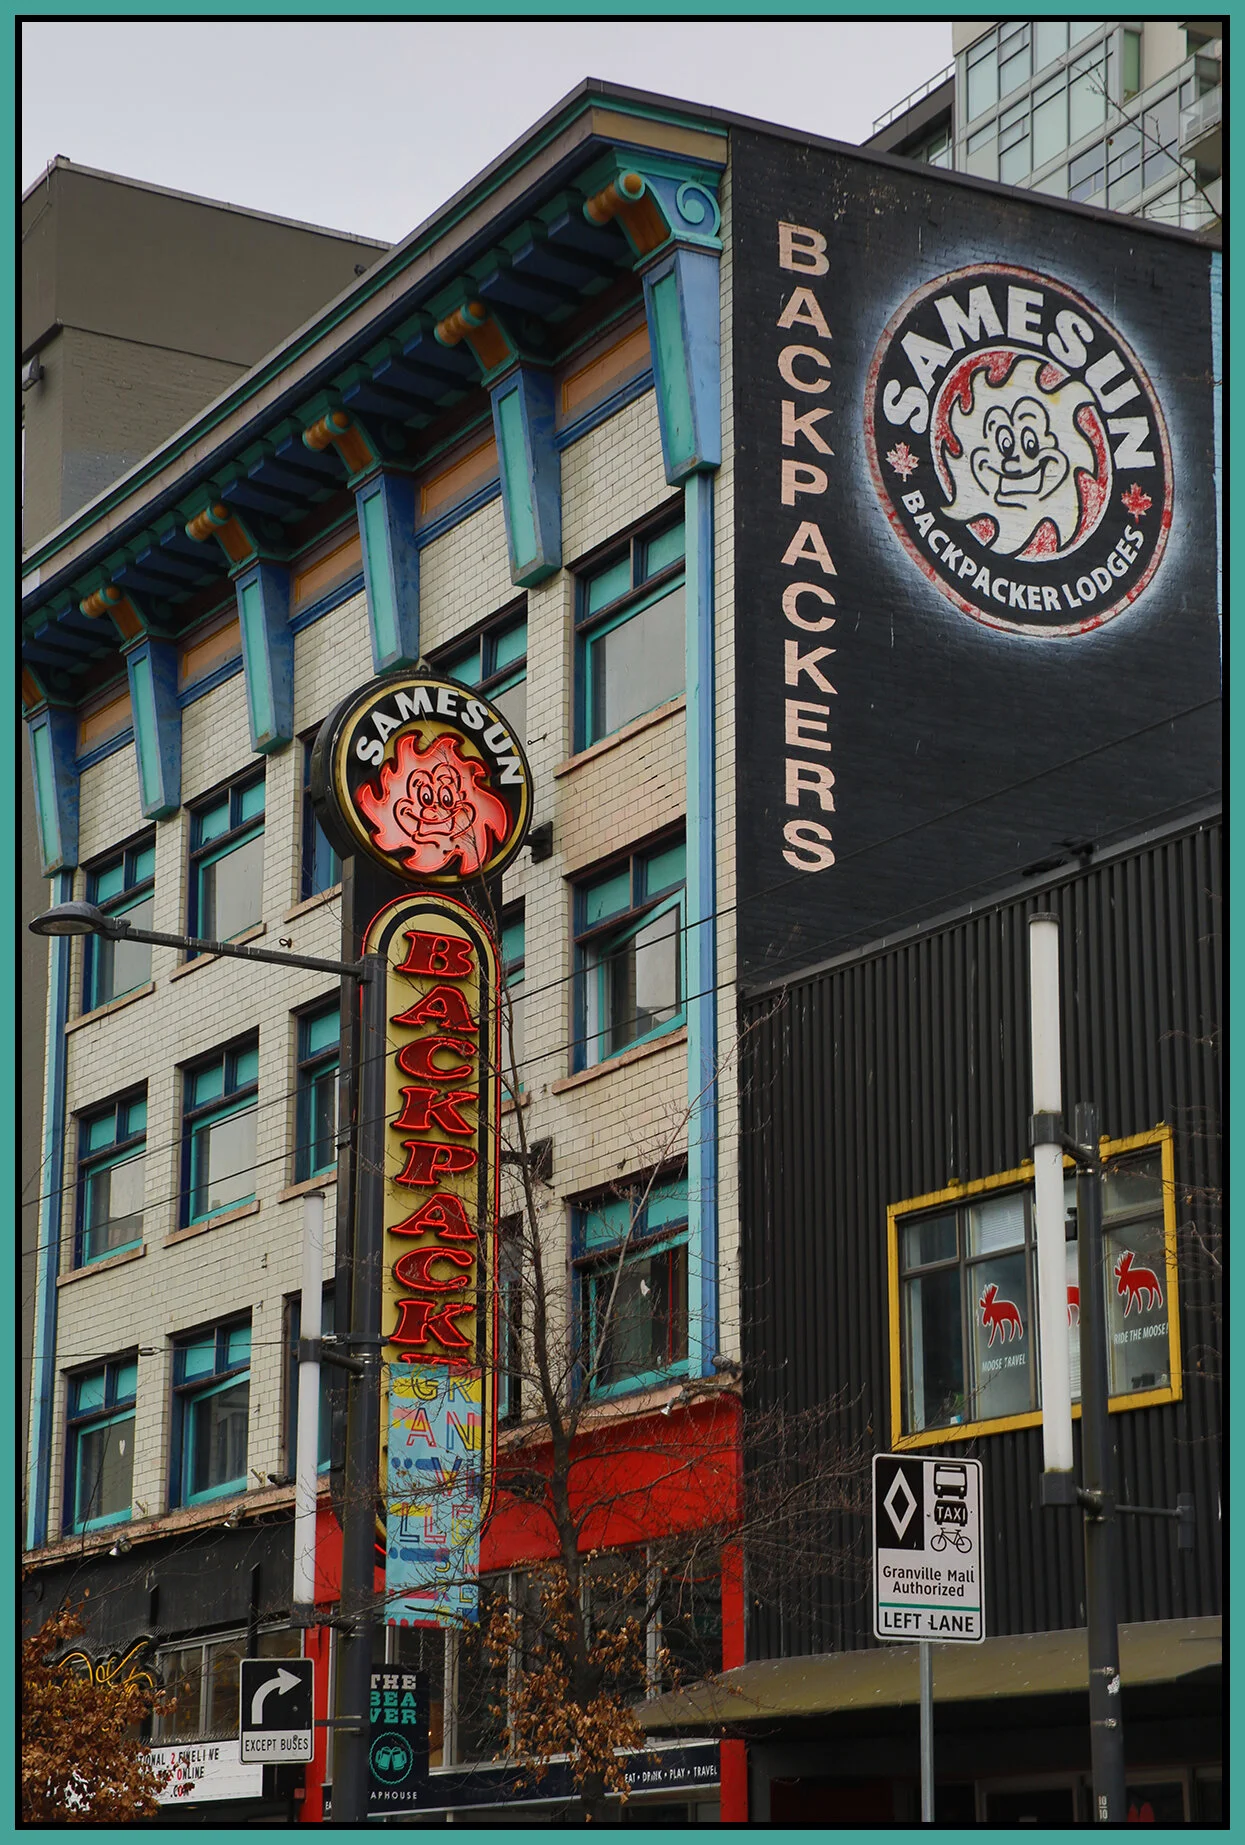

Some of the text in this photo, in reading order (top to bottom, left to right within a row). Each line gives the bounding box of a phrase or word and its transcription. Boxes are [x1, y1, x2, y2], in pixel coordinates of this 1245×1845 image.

[882, 285, 1156, 470] SAMESUN
[776, 220, 838, 874] BACKPACKERS
[901, 489, 1145, 611] BACKPACKER LODGES
[355, 687, 525, 785] SAMESUN
[389, 929, 480, 1365] BACKPACK
[1114, 1322, 1169, 1345] RIDE THE MOOSE!
[982, 1353, 1026, 1372] MOOSE TRAVEL
[936, 1505, 966, 1521] TAXI
[883, 1565, 975, 1583] Granville Mall
[893, 1581, 965, 1597] Authorized
[884, 1611, 974, 1632] LEFT LANE
[370, 1674, 416, 1690] THE
[370, 1691, 416, 1707] BEA
[369, 1708, 416, 1724] VER
[245, 1738, 309, 1752] EXCEPT BUSES
[625, 1773, 635, 1783] EAT
[669, 1767, 685, 1779] PLAY
[693, 1764, 717, 1778] TRAVEL
[368, 1791, 417, 1800] APHOUSE
